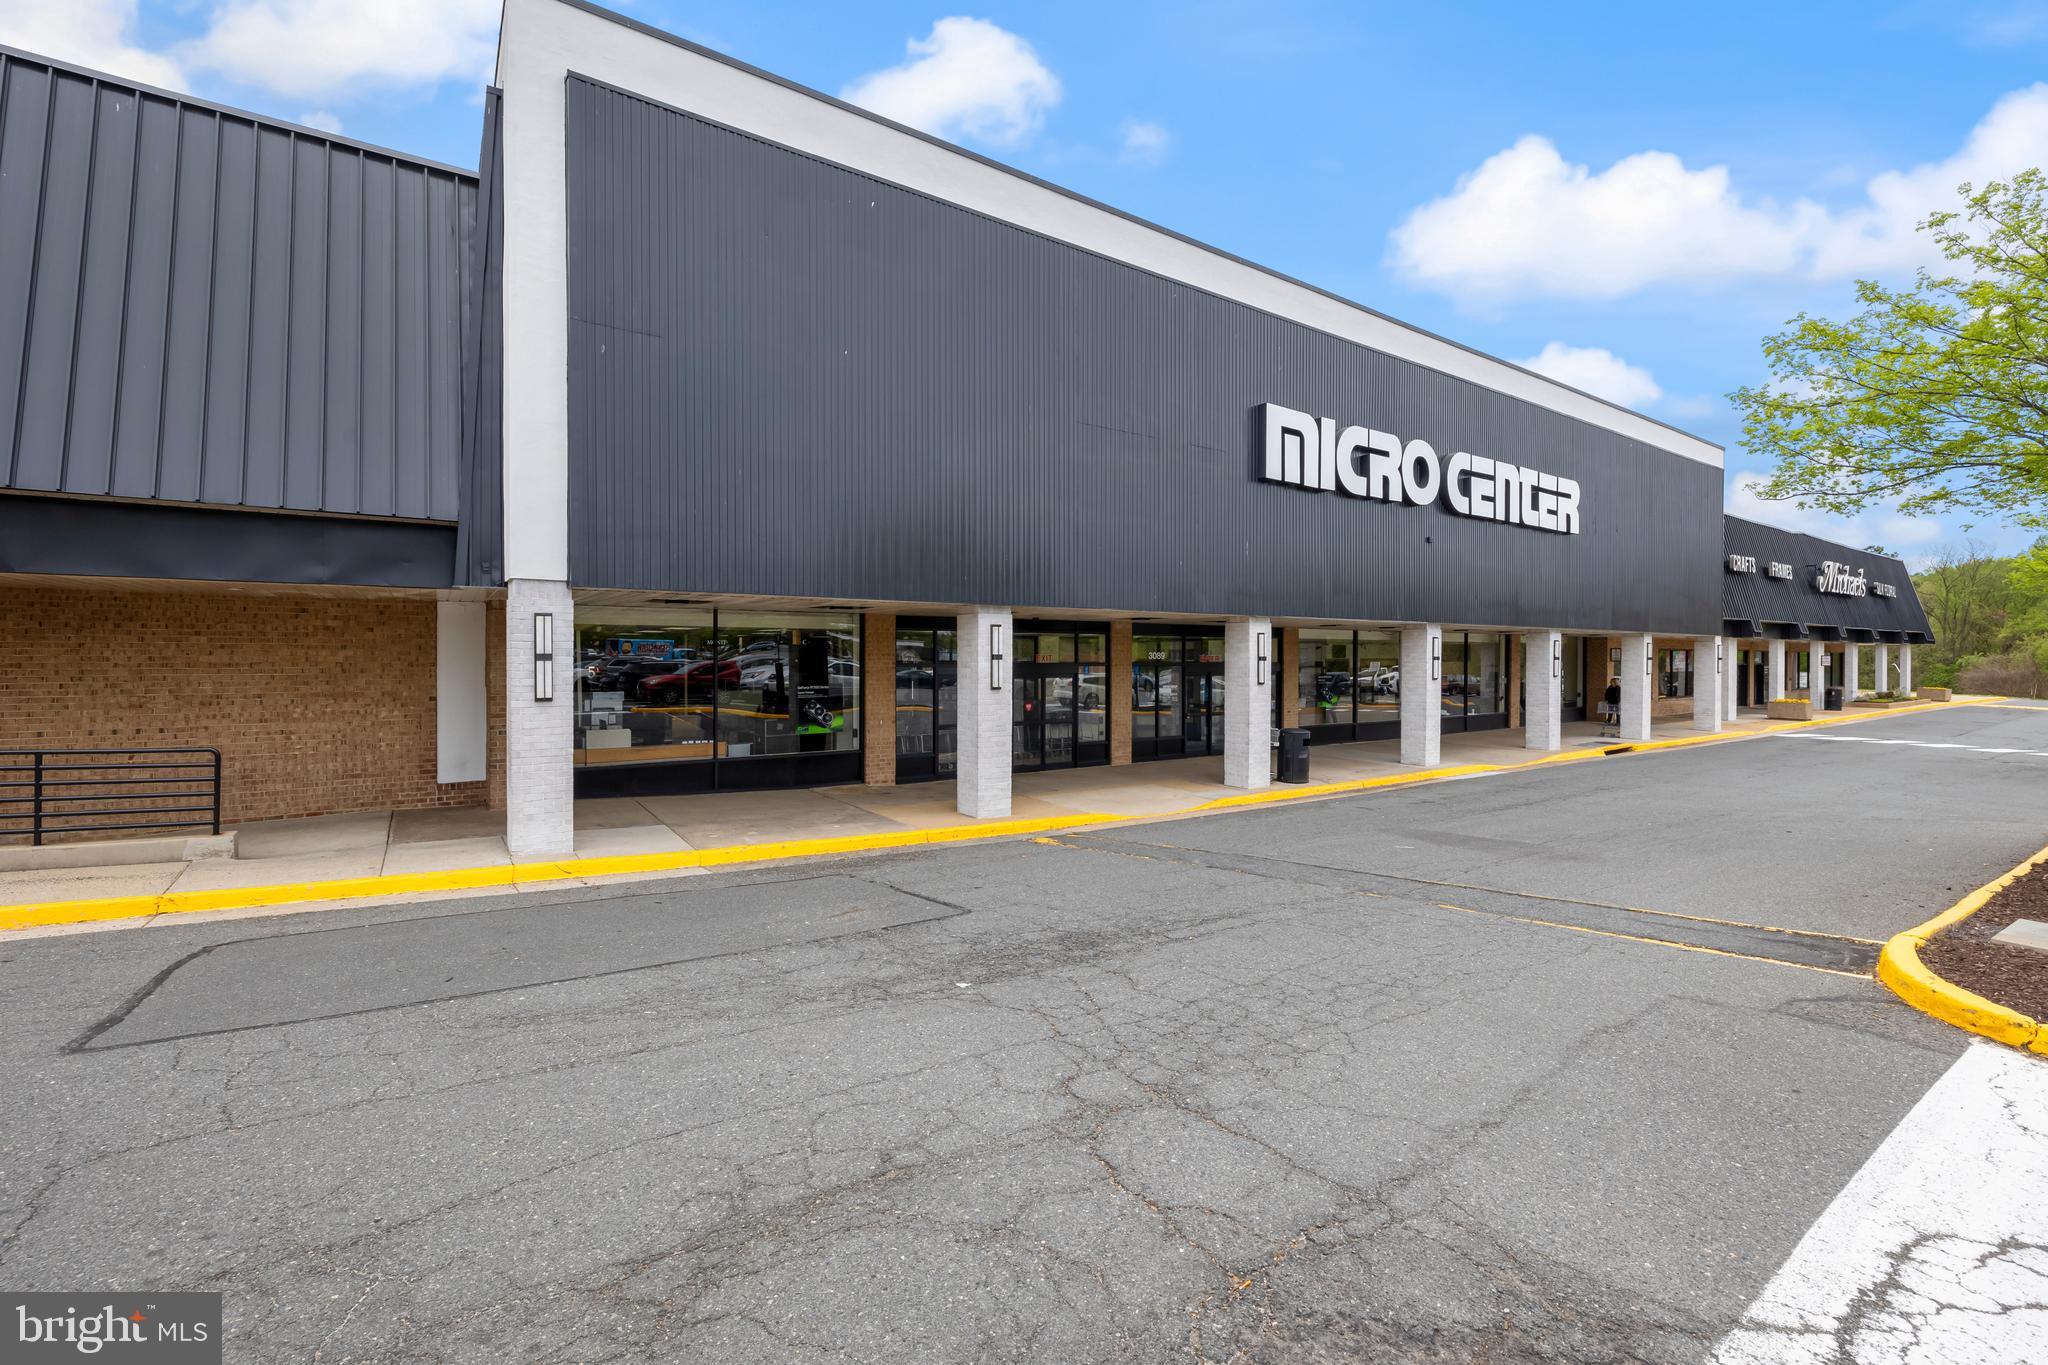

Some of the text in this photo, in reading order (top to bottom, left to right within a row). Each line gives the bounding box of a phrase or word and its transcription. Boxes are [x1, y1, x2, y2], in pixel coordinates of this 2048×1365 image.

[1264, 402, 1581, 534] MICRO CENTER
[1732, 554, 1756, 573] CRAFTS
[1770, 561, 1793, 580] FRAMES
[1818, 561, 1867, 597] Michaels
[1148, 651, 1166, 660] 3089
